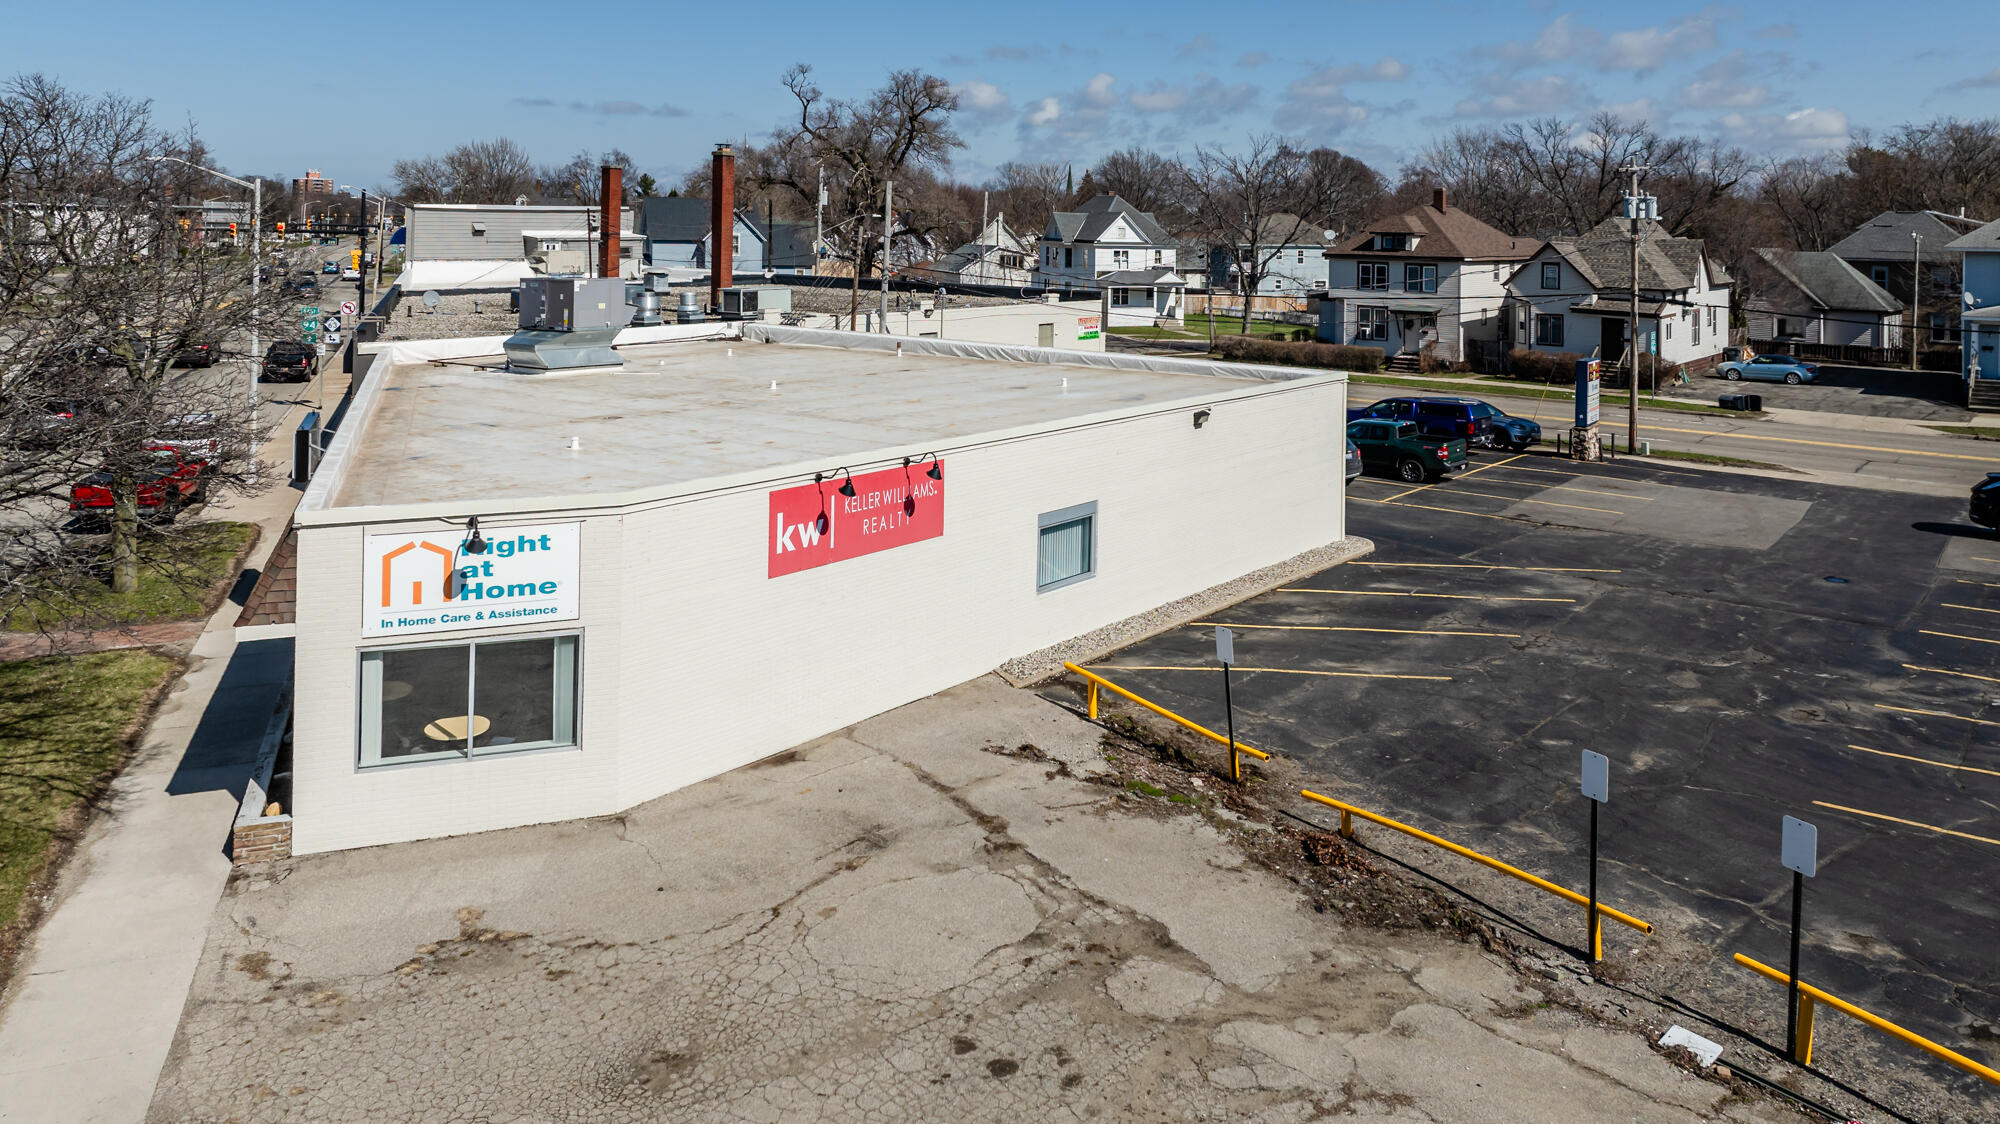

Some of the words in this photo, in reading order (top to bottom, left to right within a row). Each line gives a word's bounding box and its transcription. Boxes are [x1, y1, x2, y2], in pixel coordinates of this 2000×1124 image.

[303, 320, 316, 328] 94
[844, 491, 881, 514] KELLER
[460, 560, 494, 579] at
[460, 581, 558, 601] Home
[381, 618, 394, 629] In
[398, 616, 436, 628] Home
[440, 612, 471, 624] Care
[475, 611, 484, 621] &
[488, 606, 558, 620] Assistance
